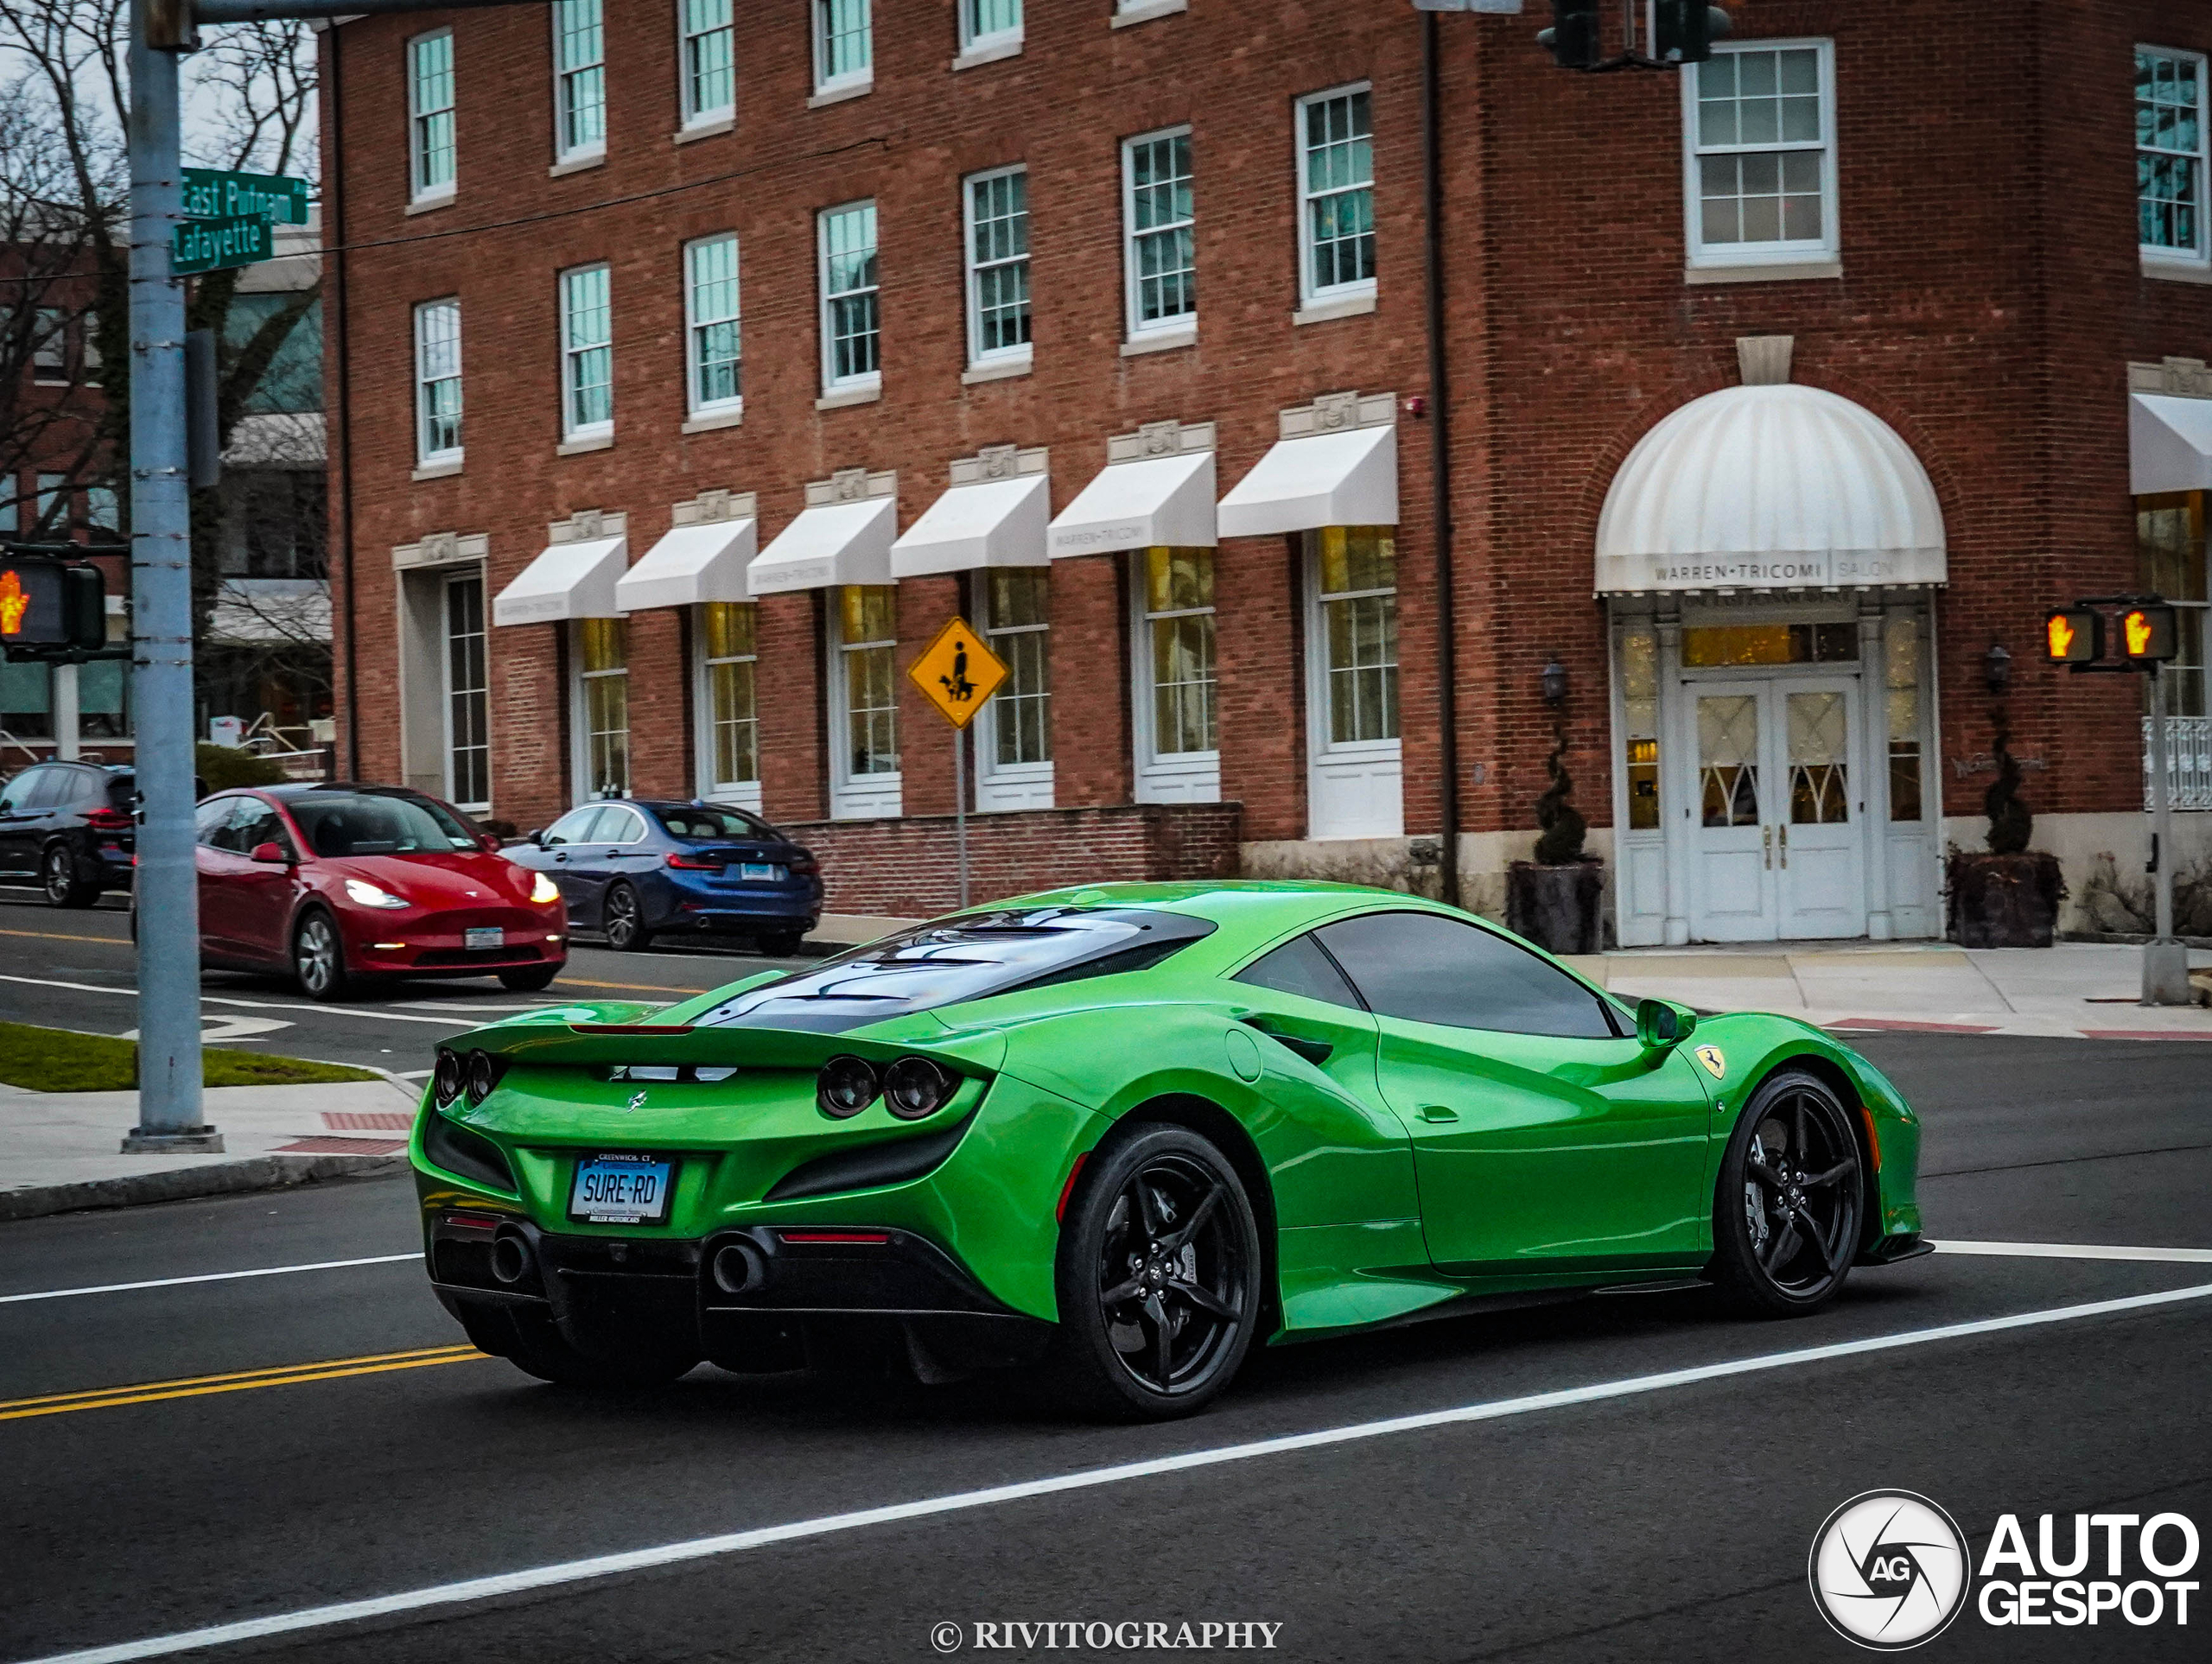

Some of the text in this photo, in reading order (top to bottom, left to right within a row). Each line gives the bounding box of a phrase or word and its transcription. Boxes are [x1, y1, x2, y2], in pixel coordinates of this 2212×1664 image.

[182, 177, 219, 215] East
[174, 219, 261, 266] Lafayette
[1838, 562, 1894, 577] SALON
